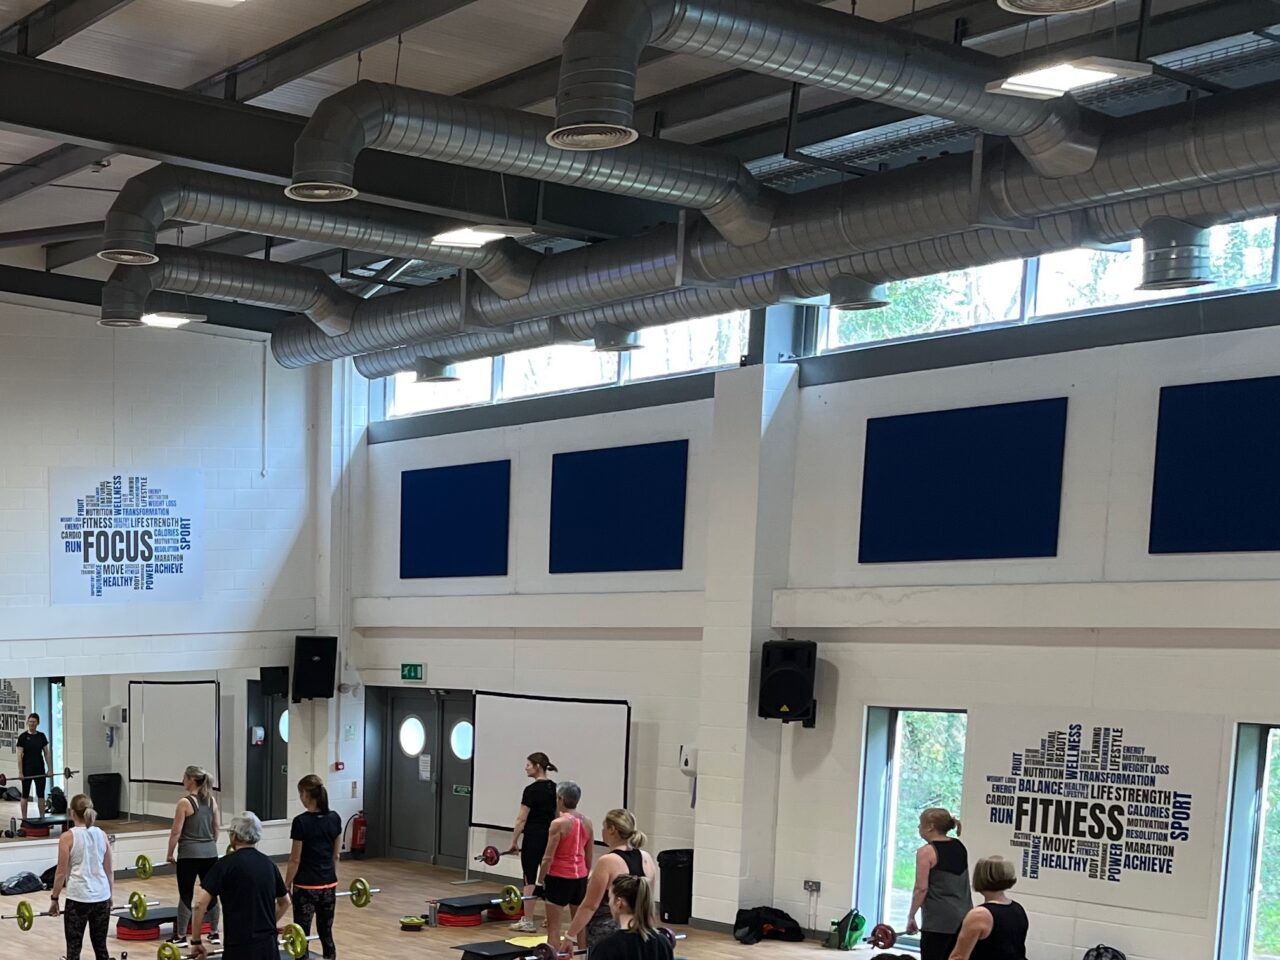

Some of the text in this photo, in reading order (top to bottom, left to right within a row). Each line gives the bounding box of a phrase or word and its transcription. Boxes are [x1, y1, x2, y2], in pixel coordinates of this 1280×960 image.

[113, 476, 121, 515] WELLNESS
[123, 508, 169, 516] TRANSFORMATION
[82, 517, 112, 528] FITNESS
[131, 517, 144, 528] LIFE
[146, 518, 179, 527] STRENGTH
[61, 531, 81, 539] CARDIO
[179, 516, 191, 550] SPORT
[65, 541, 81, 552] RUN
[83, 530, 153, 563] FOCUS
[155, 554, 183, 562] MARATHON
[103, 564, 124, 575] MOVE
[155, 563, 183, 573] ACHIEVE
[103, 576, 133, 587] HEALTHY
[1045, 731, 1057, 762] NATURAL
[1054, 731, 1066, 763] BEAUTY
[1065, 724, 1082, 780] WELLNESS
[1091, 727, 1102, 763] PLANNING
[1109, 728, 1123, 771] LIFESTYLE
[1123, 746, 1145, 755] ENERGY
[1012, 753, 1022, 776] FRUIT
[1023, 766, 1064, 780] NUTRITION
[1122, 763, 1169, 774] WEIGHT LOSS
[1019, 778, 1063, 795] BALANCE
[1064, 782, 1089, 792] HEALTHY
[1079, 770, 1156, 787] TRANSFORMATION
[992, 784, 1016, 795] ENERGY
[1063, 790, 1088, 799] LIFESTYLE
[1090, 783, 1114, 801] LIFE
[1114, 786, 1171, 806] STRENGTH
[986, 793, 1015, 806] CARDIO
[990, 807, 1013, 824] RUN
[1015, 796, 1125, 842] FITNESS
[1128, 803, 1170, 819] CALORIES
[1169, 791, 1191, 841] SPORT
[1126, 817, 1169, 831] MOTIVATION
[1126, 829, 1168, 842] RESOLUTION
[1042, 836, 1076, 854] MOVE
[1076, 847, 1099, 857] FITNESS
[1125, 840, 1174, 857] MARATHON
[1029, 834, 1041, 879] ENDURANCE
[1041, 853, 1089, 872] HEALTHY
[1107, 844, 1124, 882] POWER
[1123, 854, 1173, 874] ACHIEVE
[1088, 857, 1100, 879] BODY
